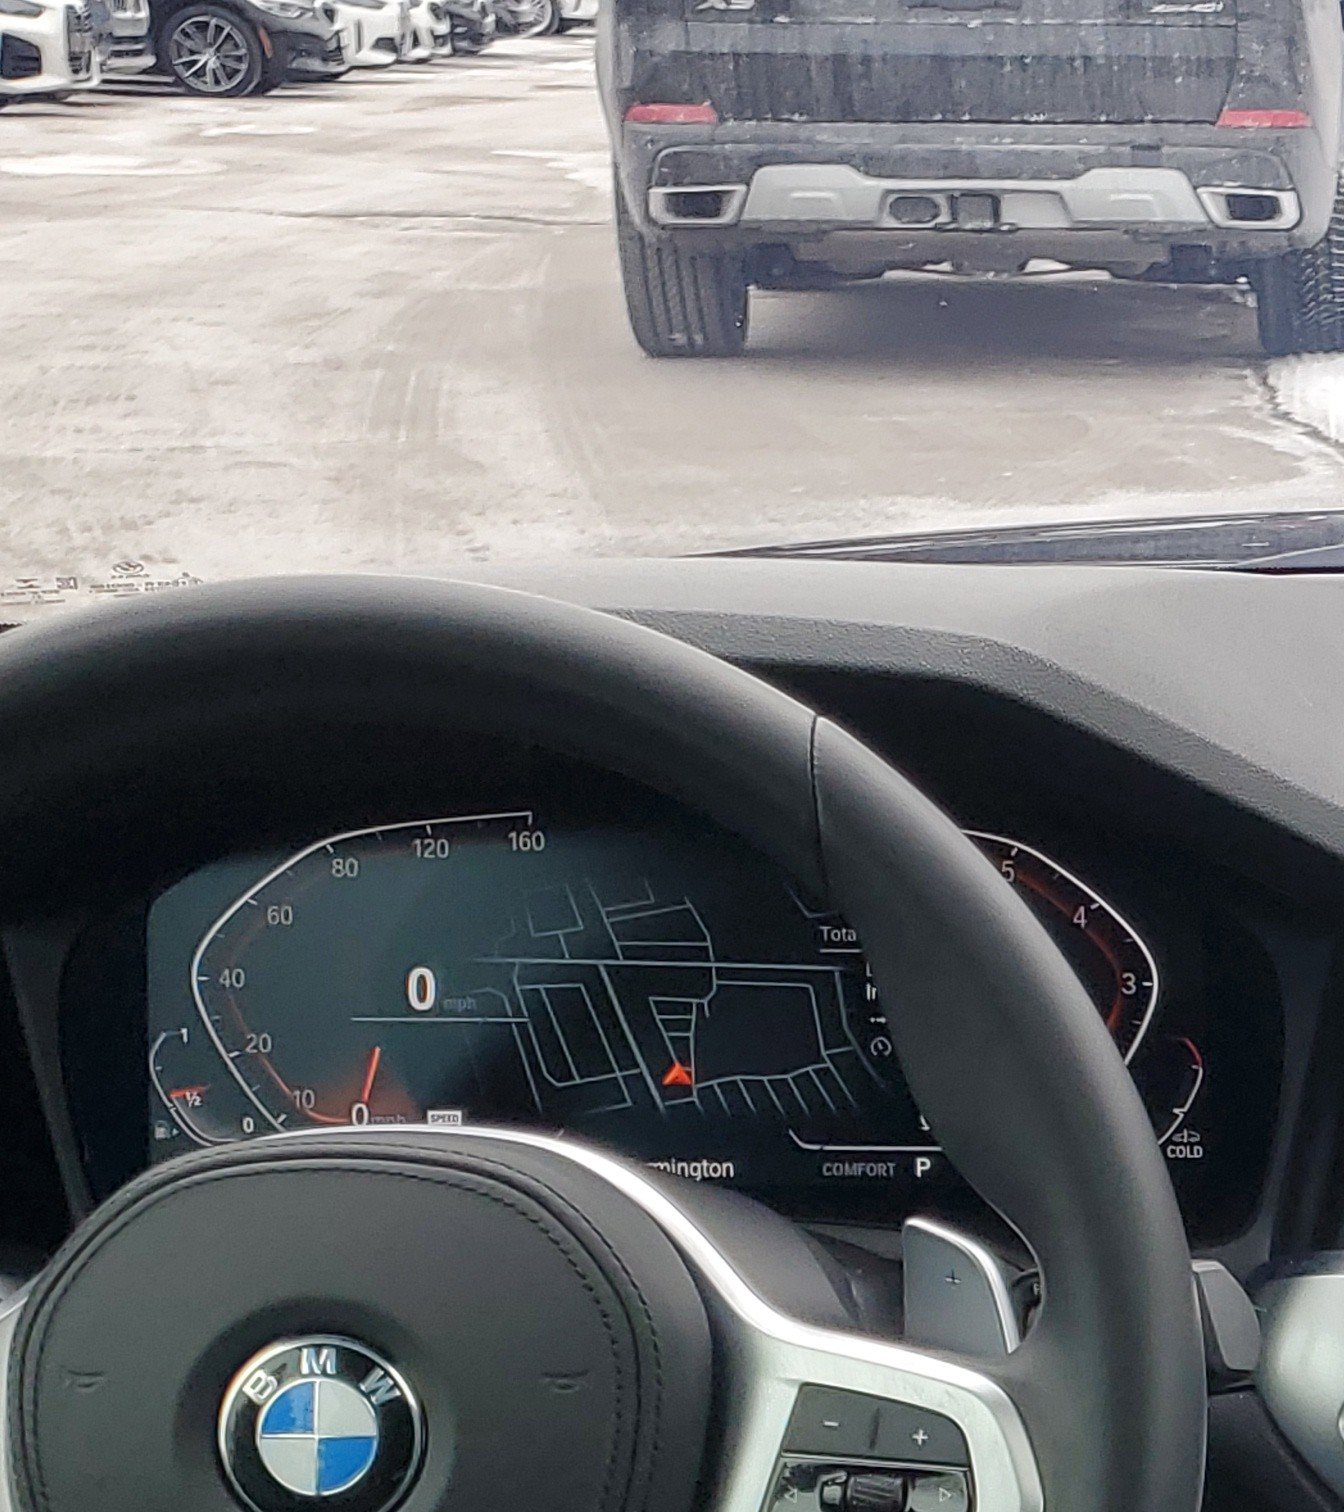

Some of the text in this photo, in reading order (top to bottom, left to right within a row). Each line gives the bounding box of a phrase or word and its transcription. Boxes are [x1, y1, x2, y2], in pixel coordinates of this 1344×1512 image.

[413, 838, 449, 859] 120
[508, 831, 545, 852] 160
[331, 858, 358, 878] 80
[266, 905, 293, 926] 60
[1073, 907, 1087, 928] 4
[819, 926, 857, 942] Tota
[219, 968, 245, 988] 40
[1122, 973, 1137, 994] 3
[406, 966, 436, 1011] 0
[245, 1034, 272, 1054] 20
[351, 1103, 369, 1126] 0
[242, 1117, 255, 1133] 0
[1166, 1145, 1203, 1159] COLD
[821, 1162, 896, 1178] COMFORT
[914, 1159, 931, 1177] P
[243, 1347, 401, 1405] BMW
